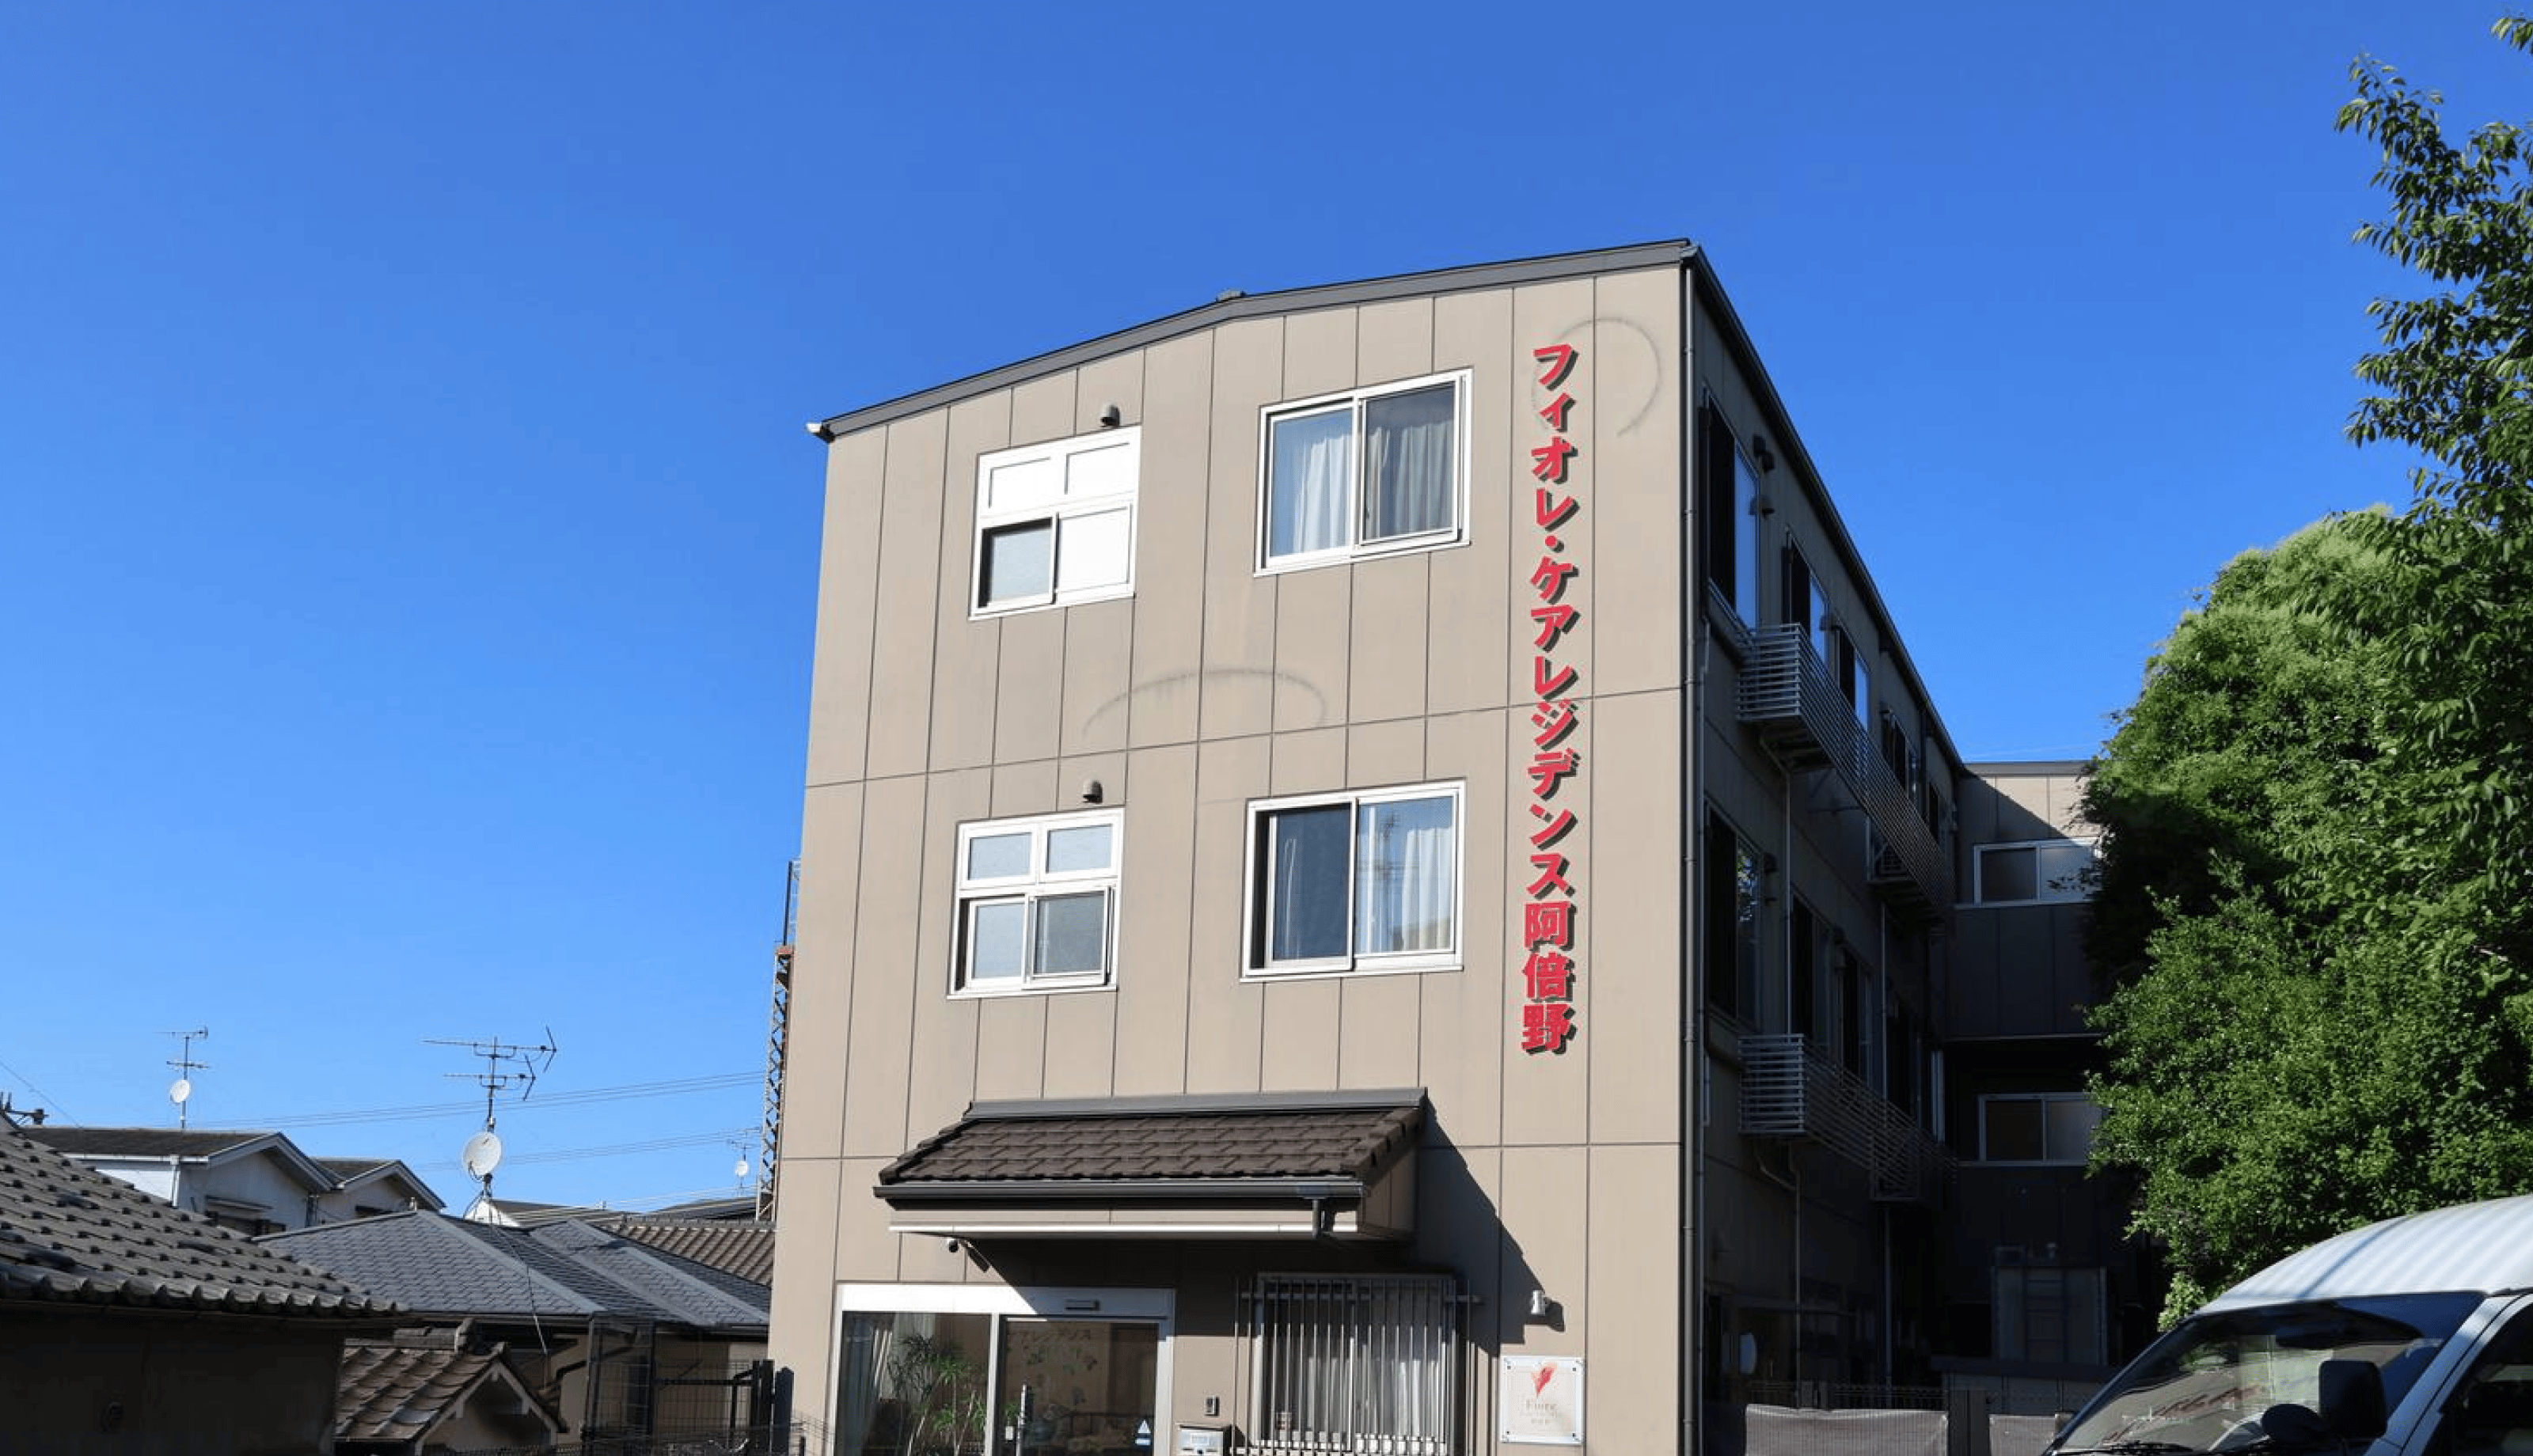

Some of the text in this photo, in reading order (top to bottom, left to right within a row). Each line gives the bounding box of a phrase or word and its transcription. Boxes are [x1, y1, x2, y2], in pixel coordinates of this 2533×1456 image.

[1521, 343, 1579, 1053] フィオレ・ケアレジデンス阿倍野
